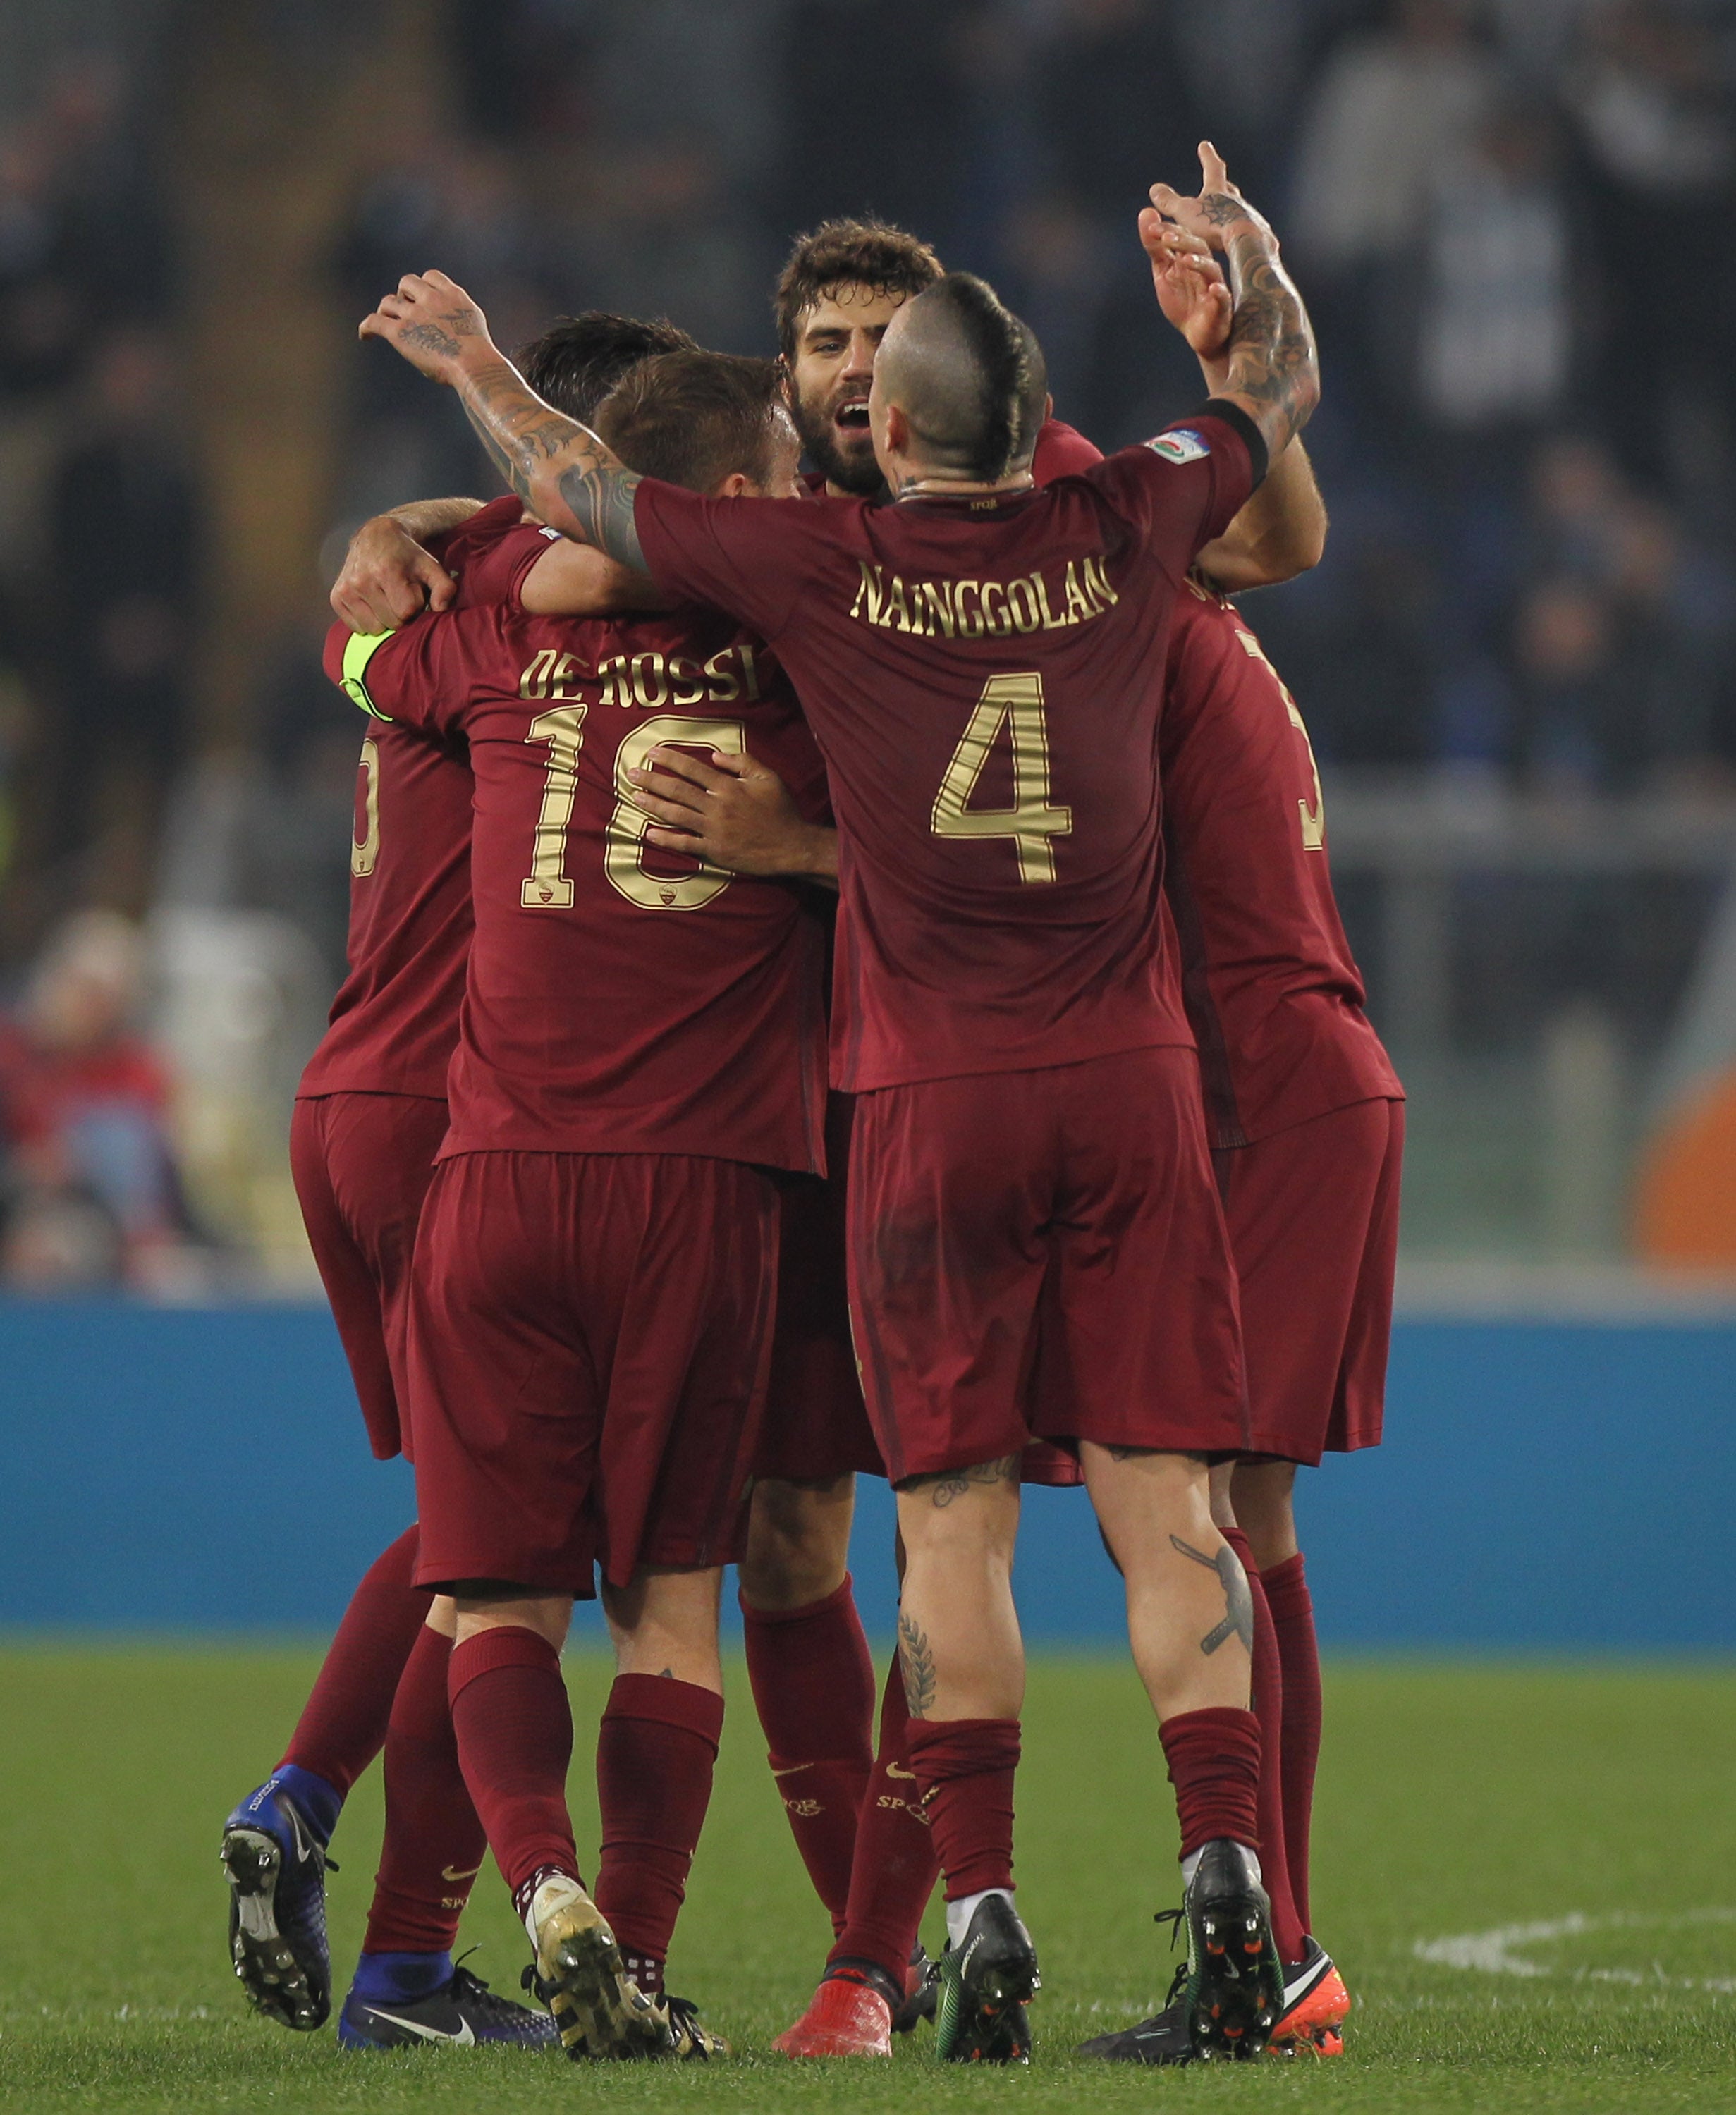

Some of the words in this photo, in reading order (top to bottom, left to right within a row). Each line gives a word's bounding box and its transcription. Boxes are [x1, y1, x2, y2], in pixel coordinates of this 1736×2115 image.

[849, 556, 1119, 638] NAINGGOLAN
[519, 649, 590, 700] DE
[597, 645, 762, 709] ROSSI
[520, 703, 747, 912] 16
[931, 671, 1072, 885] 4
[876, 1796, 931, 1826] SPQ
